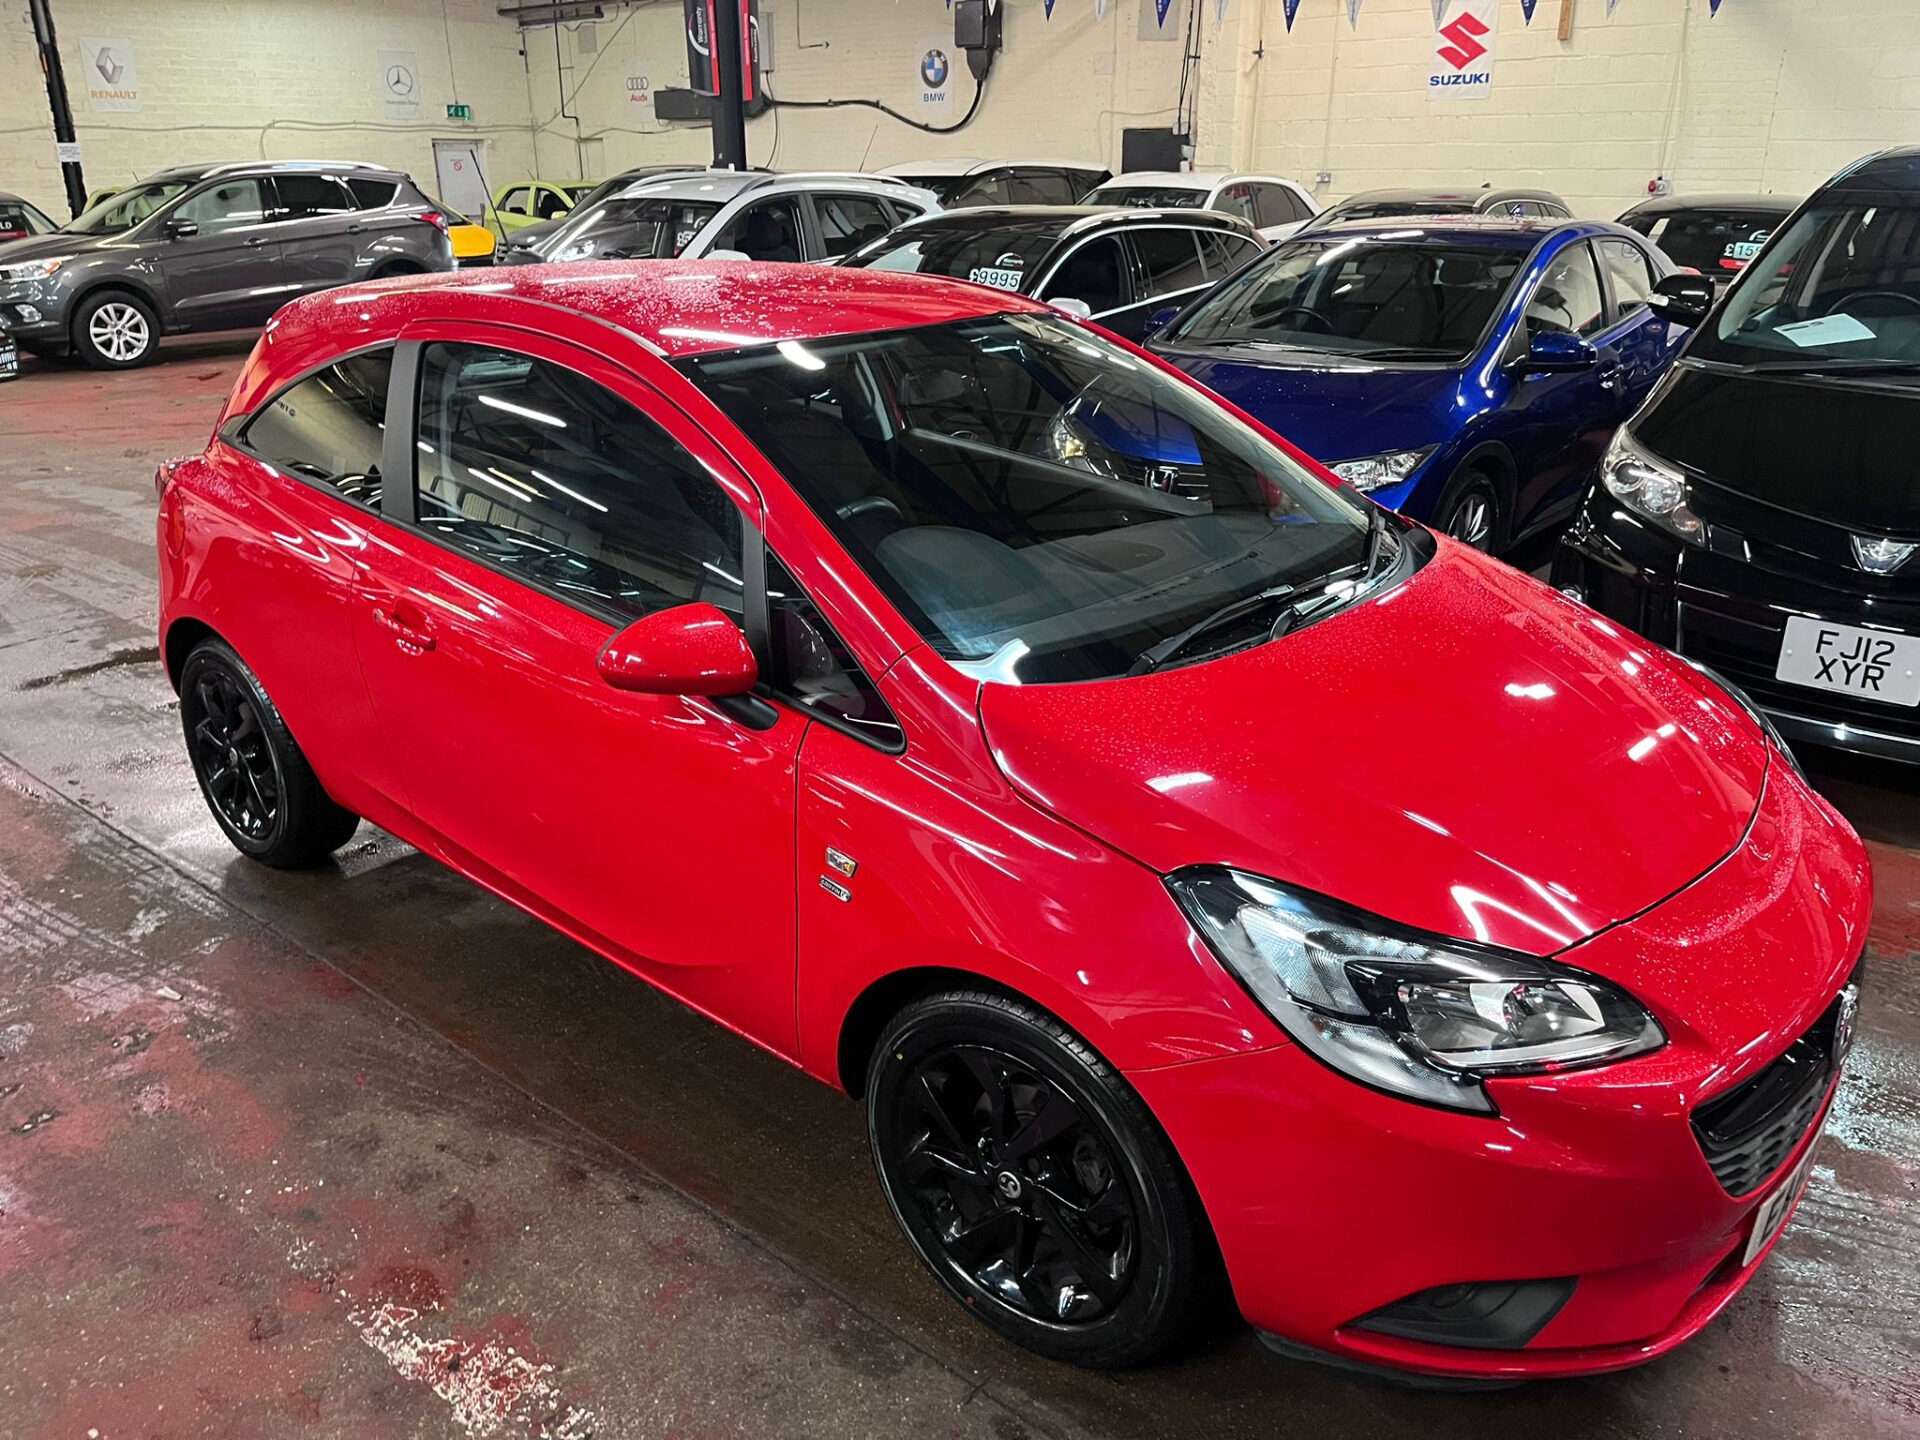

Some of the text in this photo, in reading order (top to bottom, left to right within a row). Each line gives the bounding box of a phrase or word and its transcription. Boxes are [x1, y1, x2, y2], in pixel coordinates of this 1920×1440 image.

[1429, 73, 1490, 86] SUZUKI
[90, 89, 137, 100] RENAULT
[923, 92, 945, 102] BMW
[1815, 629, 1896, 667] FJ12
[1814, 656, 1885, 691] XYR
